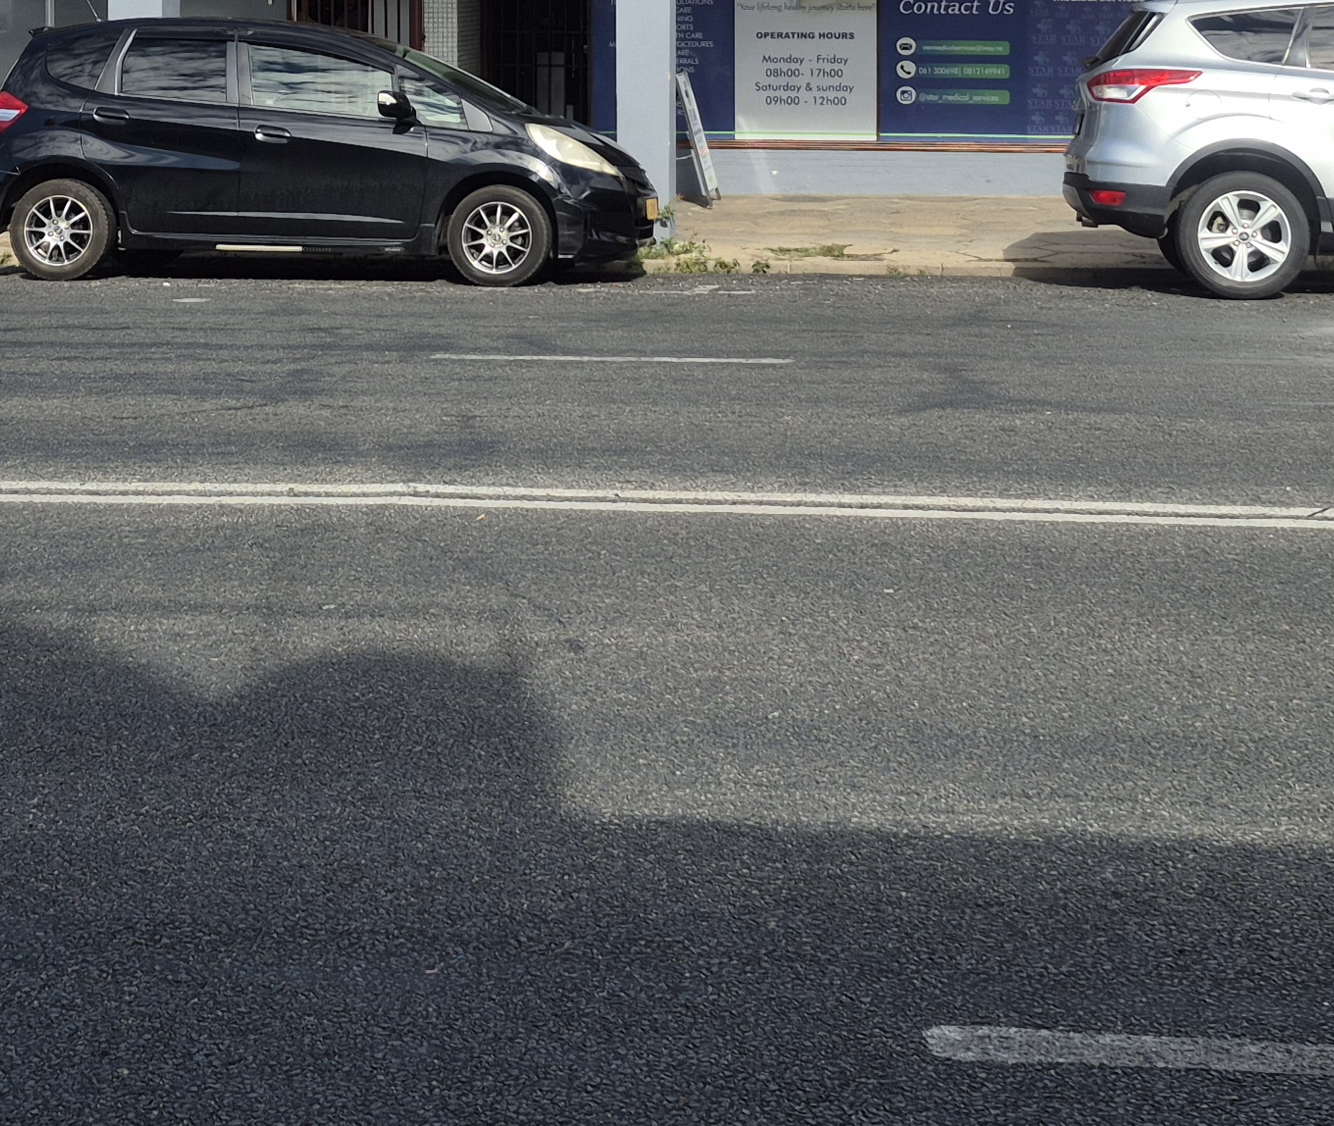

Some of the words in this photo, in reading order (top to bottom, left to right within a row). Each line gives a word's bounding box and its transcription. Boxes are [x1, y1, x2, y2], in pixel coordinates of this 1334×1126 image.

[899, 0, 981, 14] Contact
[988, 0, 1015, 14] Us
[756, 32, 816, 40] OPERATING
[818, 32, 855, 40] HOURS
[762, 54, 805, 66] Monday
[816, 54, 849, 66] Friday
[810, 68, 844, 78] 17h00
[755, 82, 802, 93] Saturday
[805, 82, 813, 92] &
[816, 82, 855, 93] sunday
[765, 96, 800, 106] 09h00
[813, 96, 847, 106] 12h00
